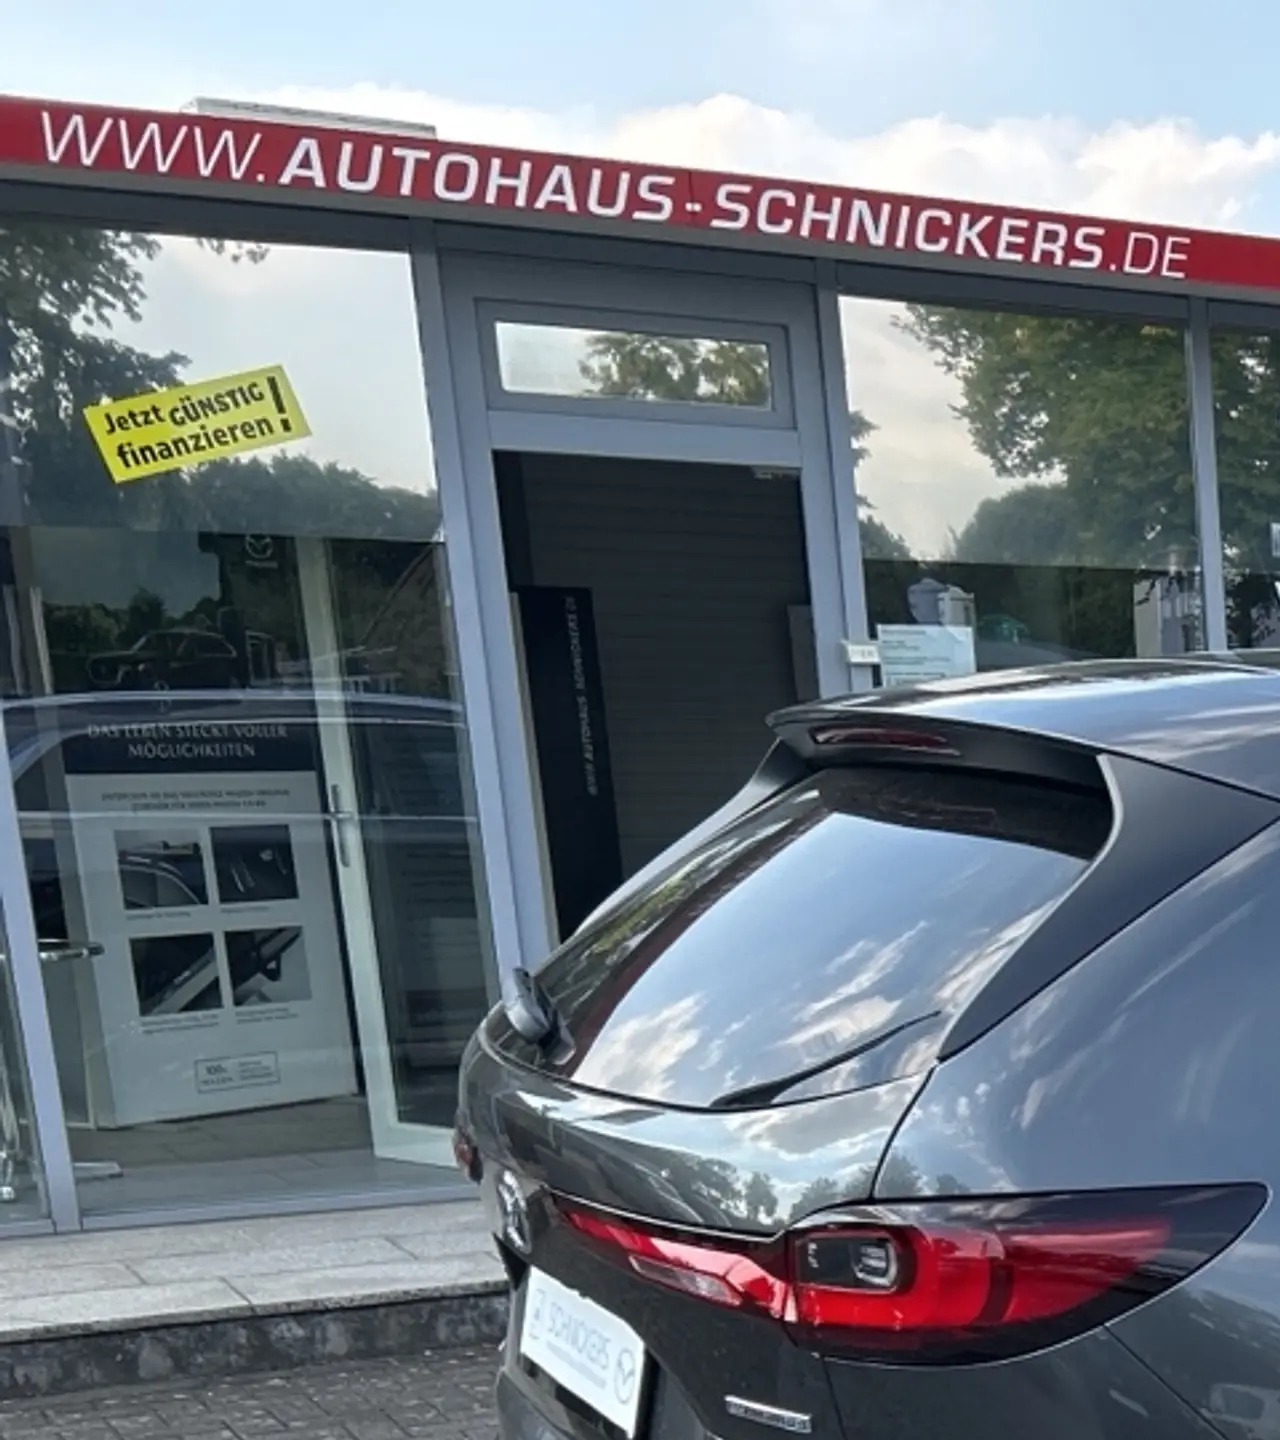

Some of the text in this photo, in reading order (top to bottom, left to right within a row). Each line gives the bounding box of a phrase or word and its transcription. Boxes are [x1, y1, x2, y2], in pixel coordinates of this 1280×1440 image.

[41, 110, 1192, 279] WWW.AUTOHAUS-SCHNICKERS.DE
[104, 381, 265, 435] Jetzt GÜNSTIG
